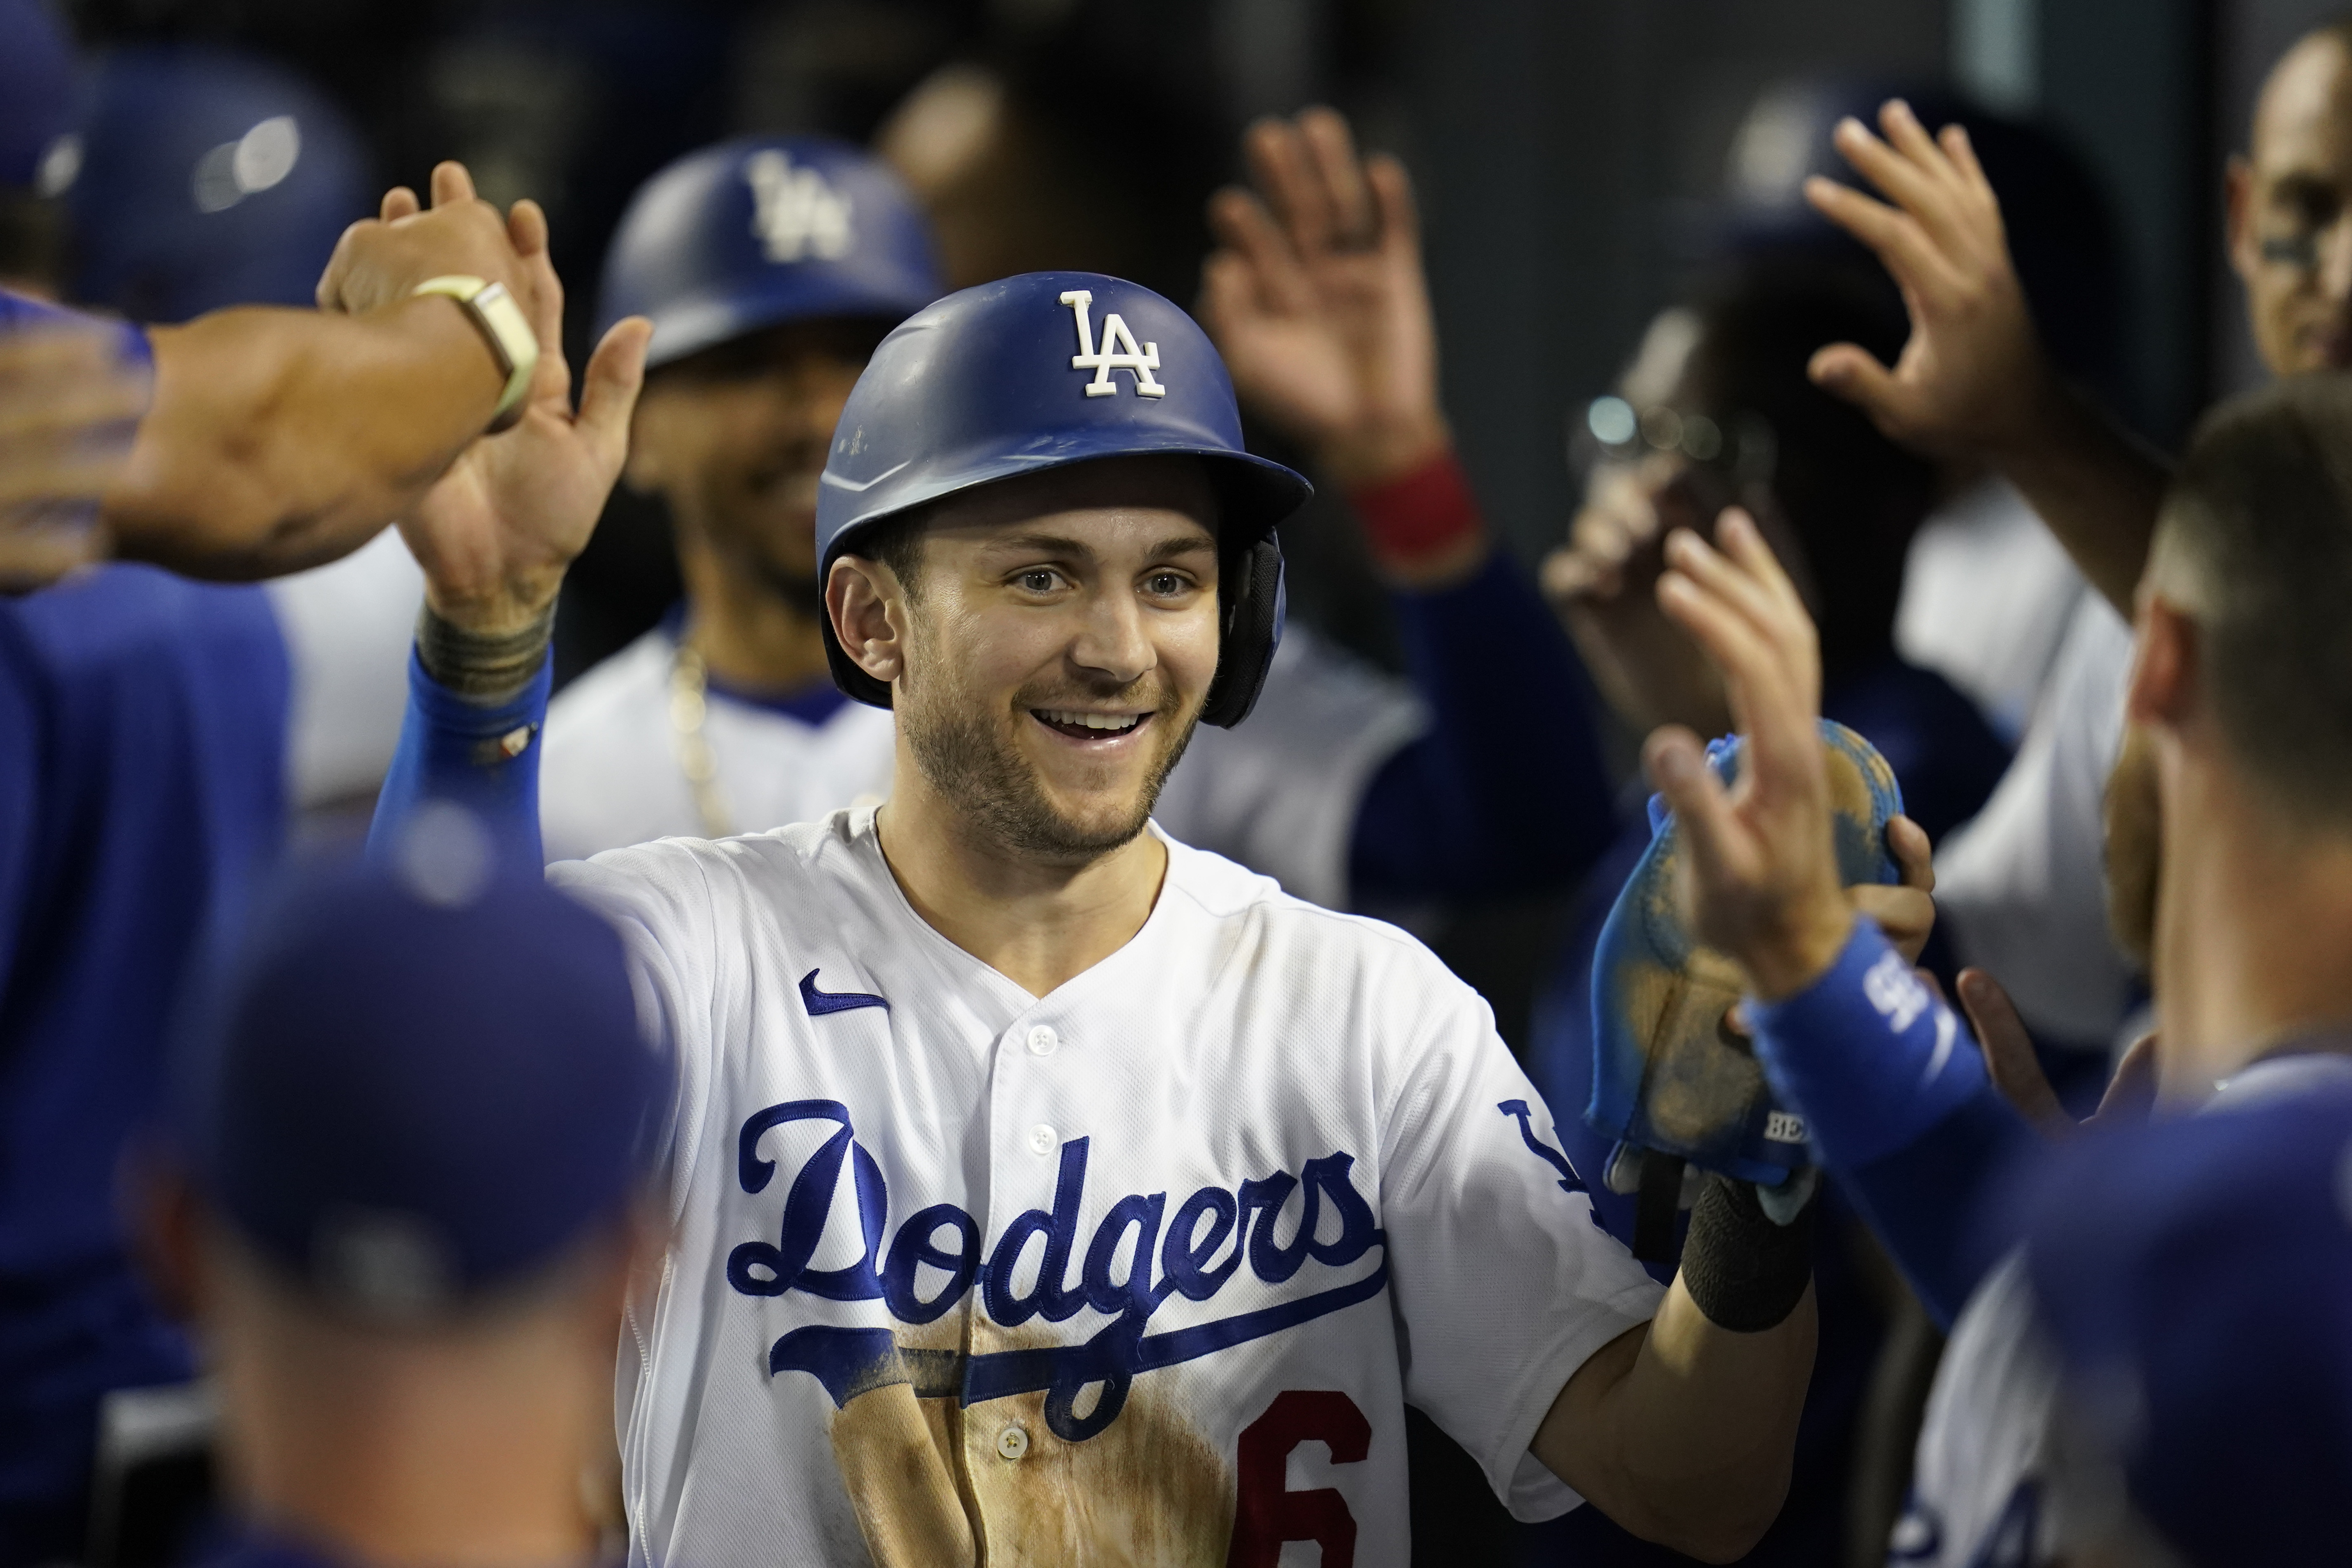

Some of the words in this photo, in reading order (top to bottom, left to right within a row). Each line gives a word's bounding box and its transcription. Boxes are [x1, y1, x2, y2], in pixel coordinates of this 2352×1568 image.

[1059, 290, 1165, 397] LA
[1497, 1099, 1612, 1237] L
[726, 1099, 1388, 1442] Dodgers
[1225, 1390, 1372, 1568] 6
